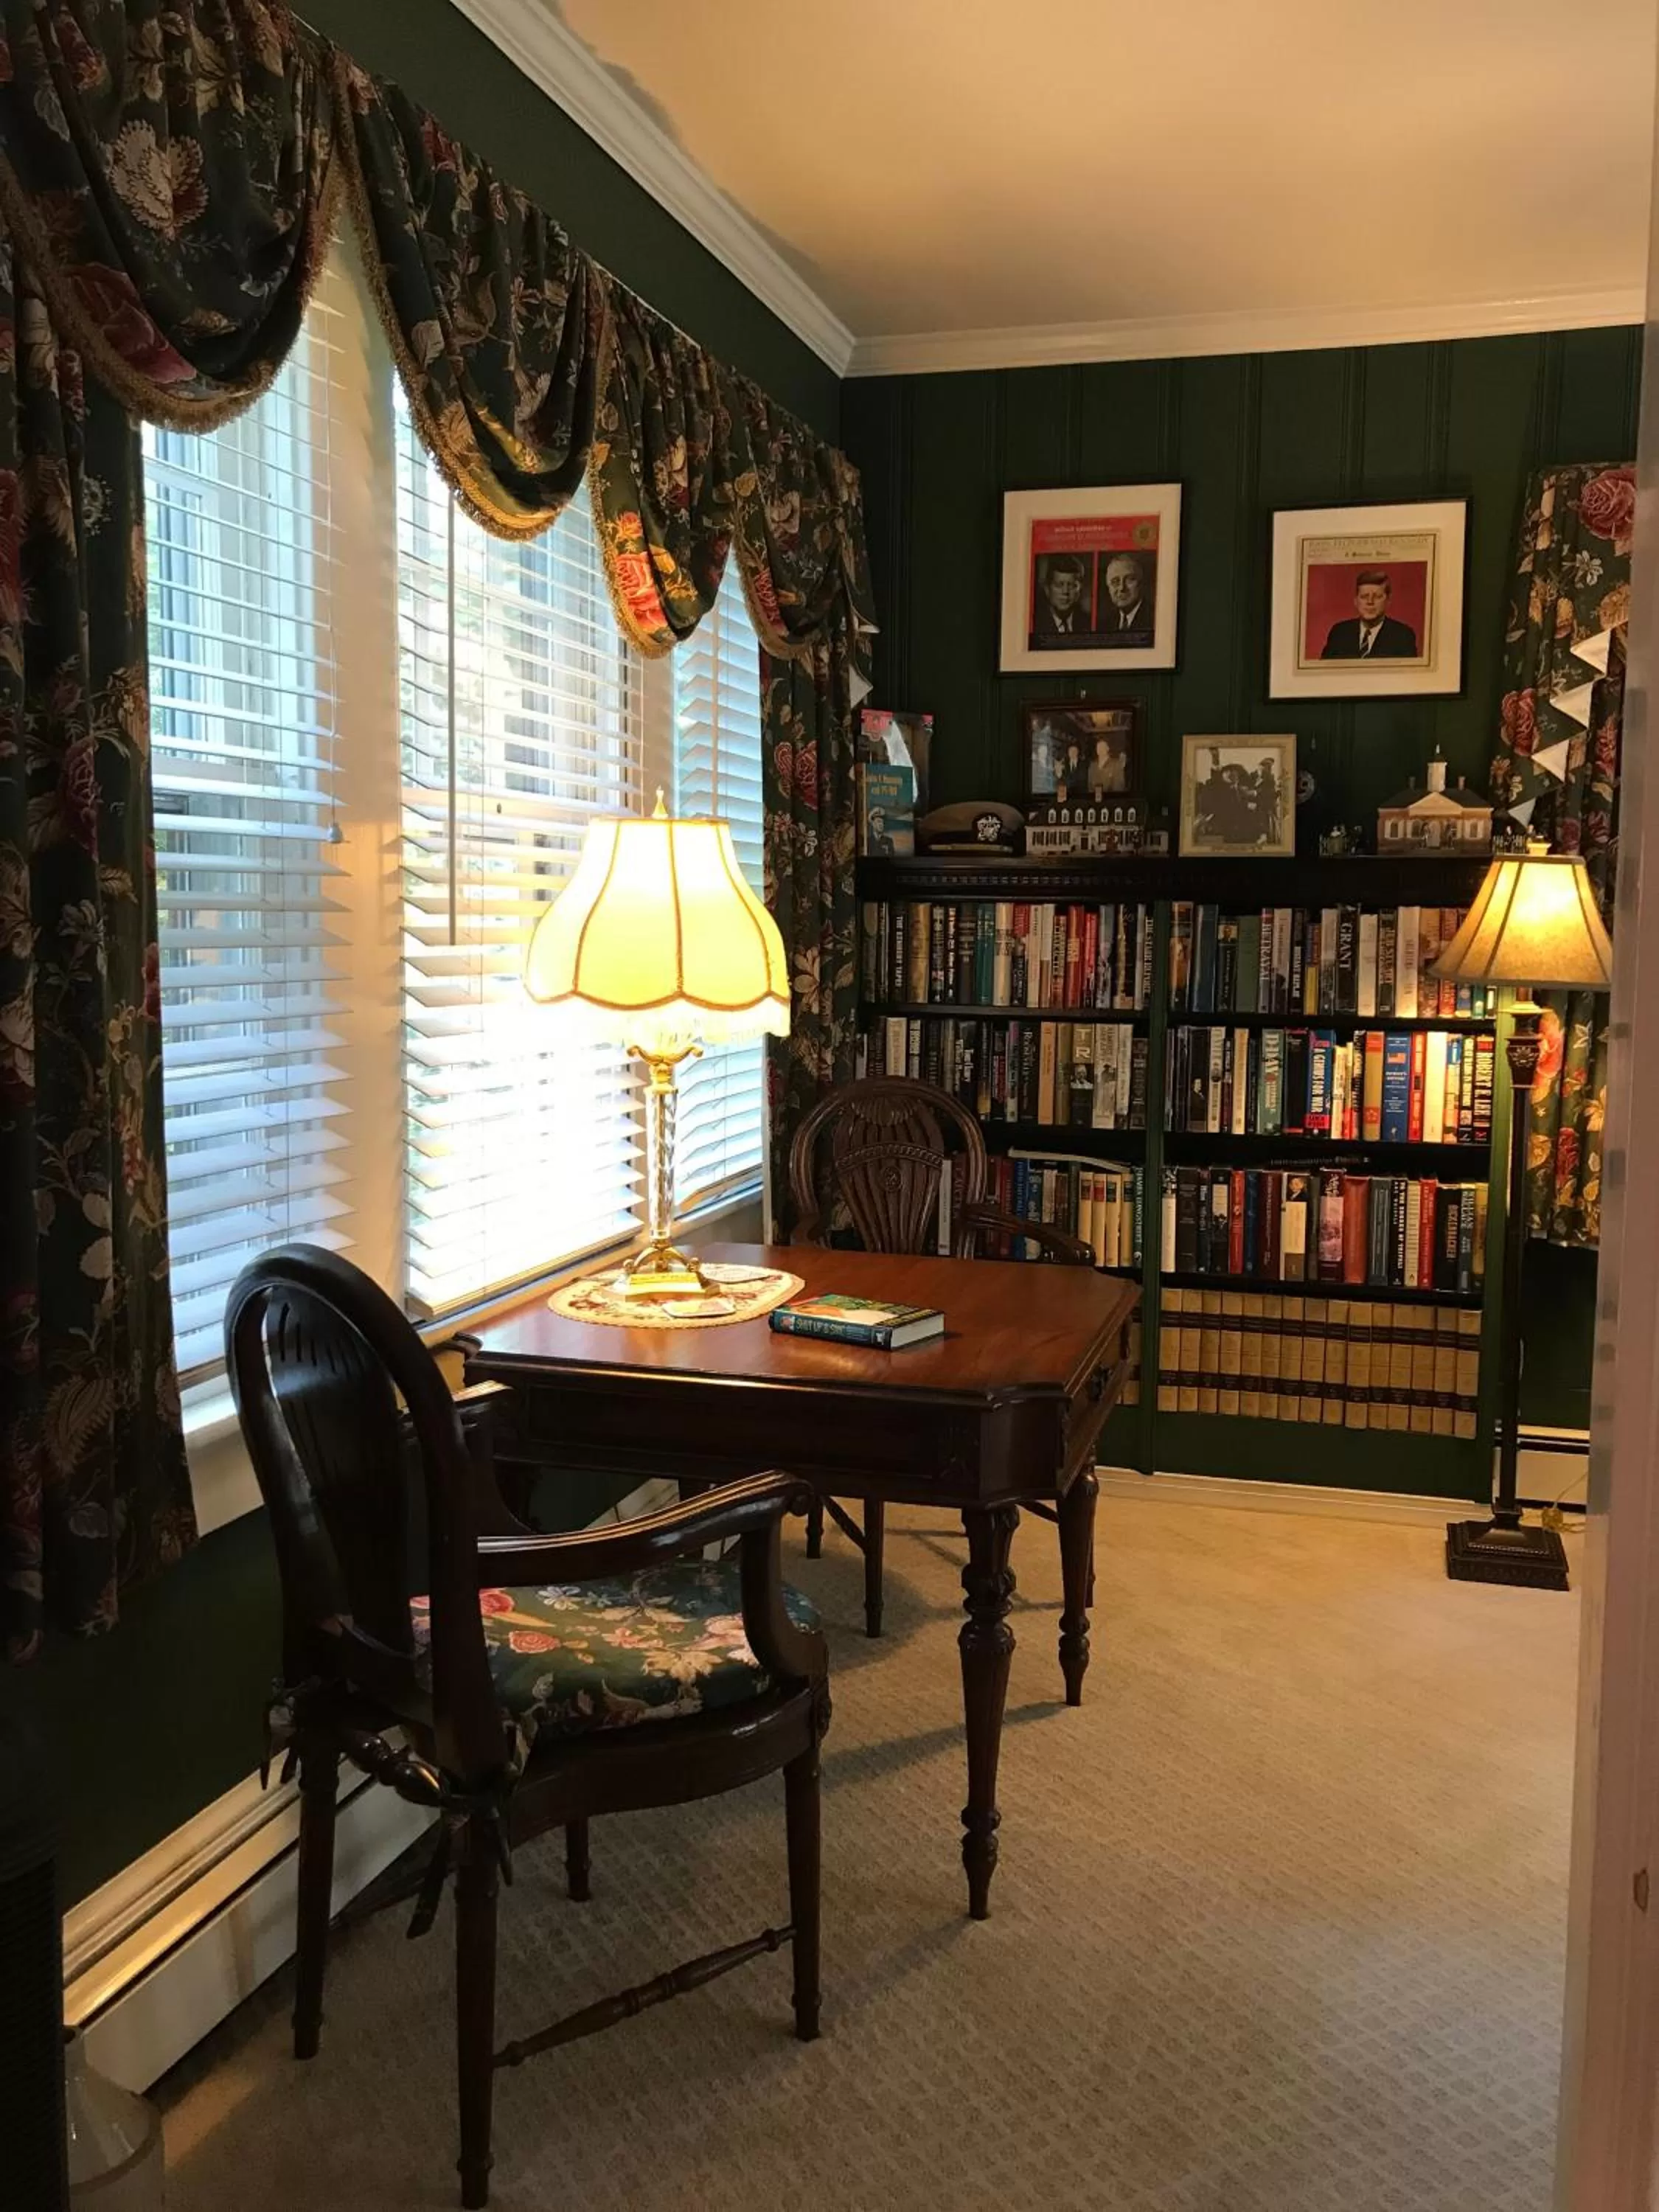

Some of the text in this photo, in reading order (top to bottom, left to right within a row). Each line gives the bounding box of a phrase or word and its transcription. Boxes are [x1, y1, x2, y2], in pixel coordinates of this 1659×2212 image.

[1340, 922, 1352, 969] GRANT
[1475, 1052, 1493, 1088] ROBERT
[1474, 1099, 1492, 1116] LEE
